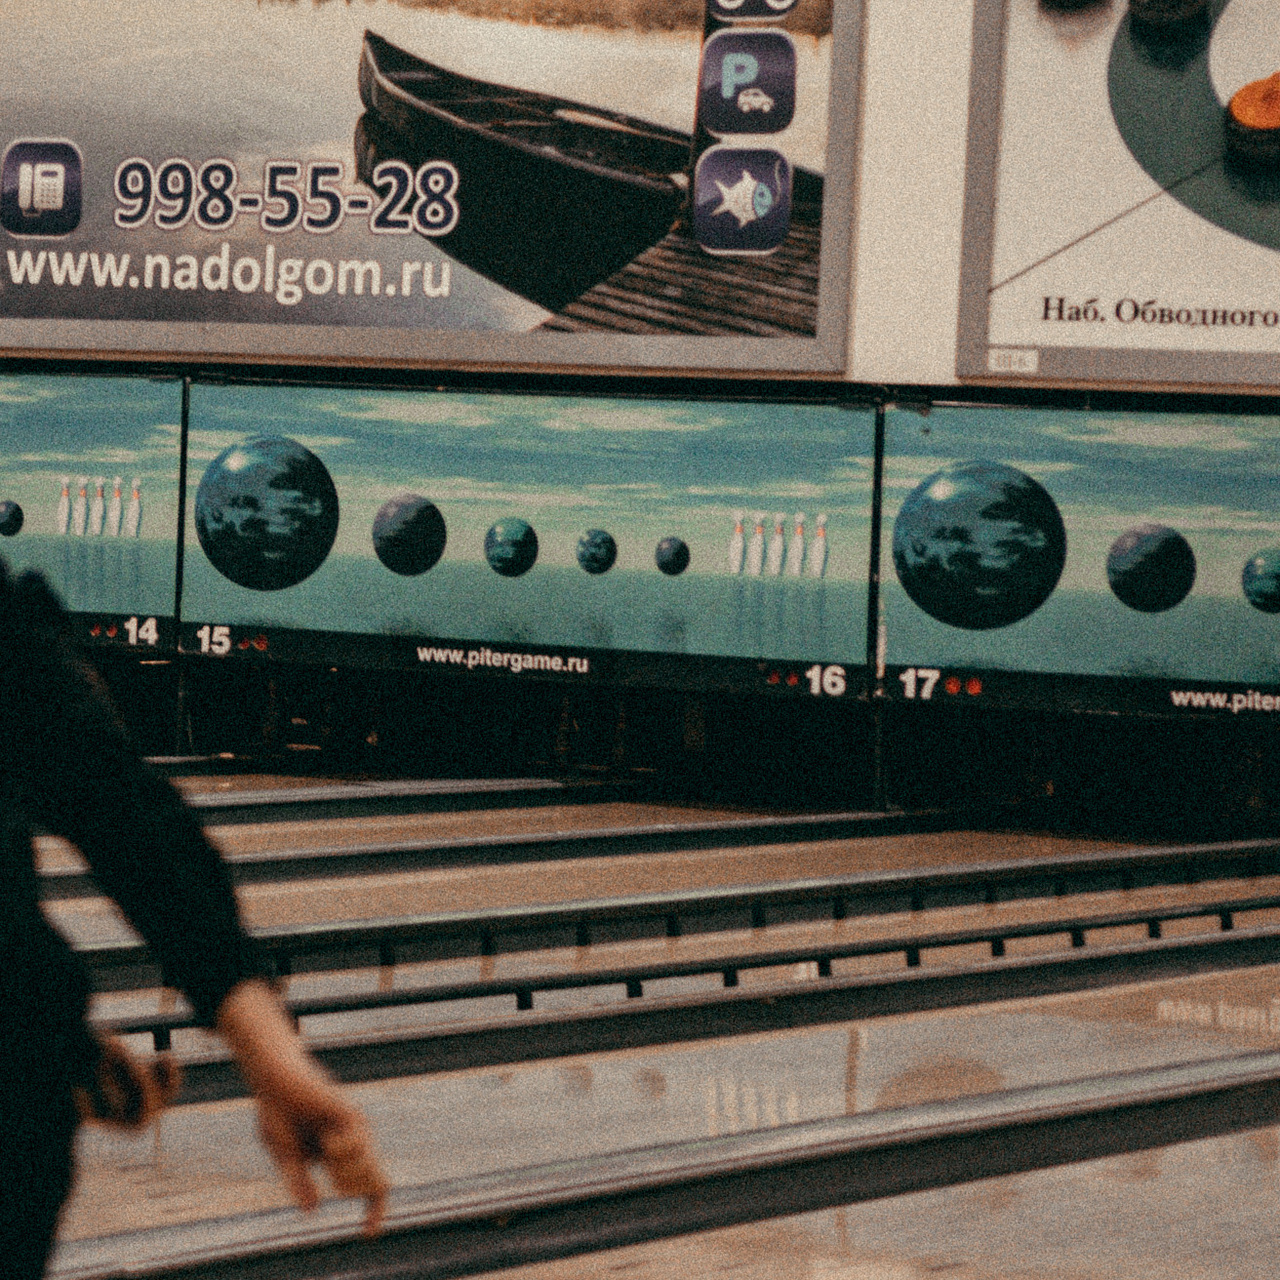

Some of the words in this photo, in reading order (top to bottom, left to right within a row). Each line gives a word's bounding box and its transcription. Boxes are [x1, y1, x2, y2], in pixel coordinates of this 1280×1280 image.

[114, 158, 459, 235] 998-55-28
[7, 242, 451, 306] www.nadolgom.ru
[1042, 296, 1105, 322] Наб.
[1115, 297, 1279, 330] Обводного
[124, 616, 159, 646] 14
[197, 625, 231, 656] 15
[417, 645, 589, 674] www.pitergame.ru
[805, 665, 847, 696] 16
[899, 668, 940, 700] 17
